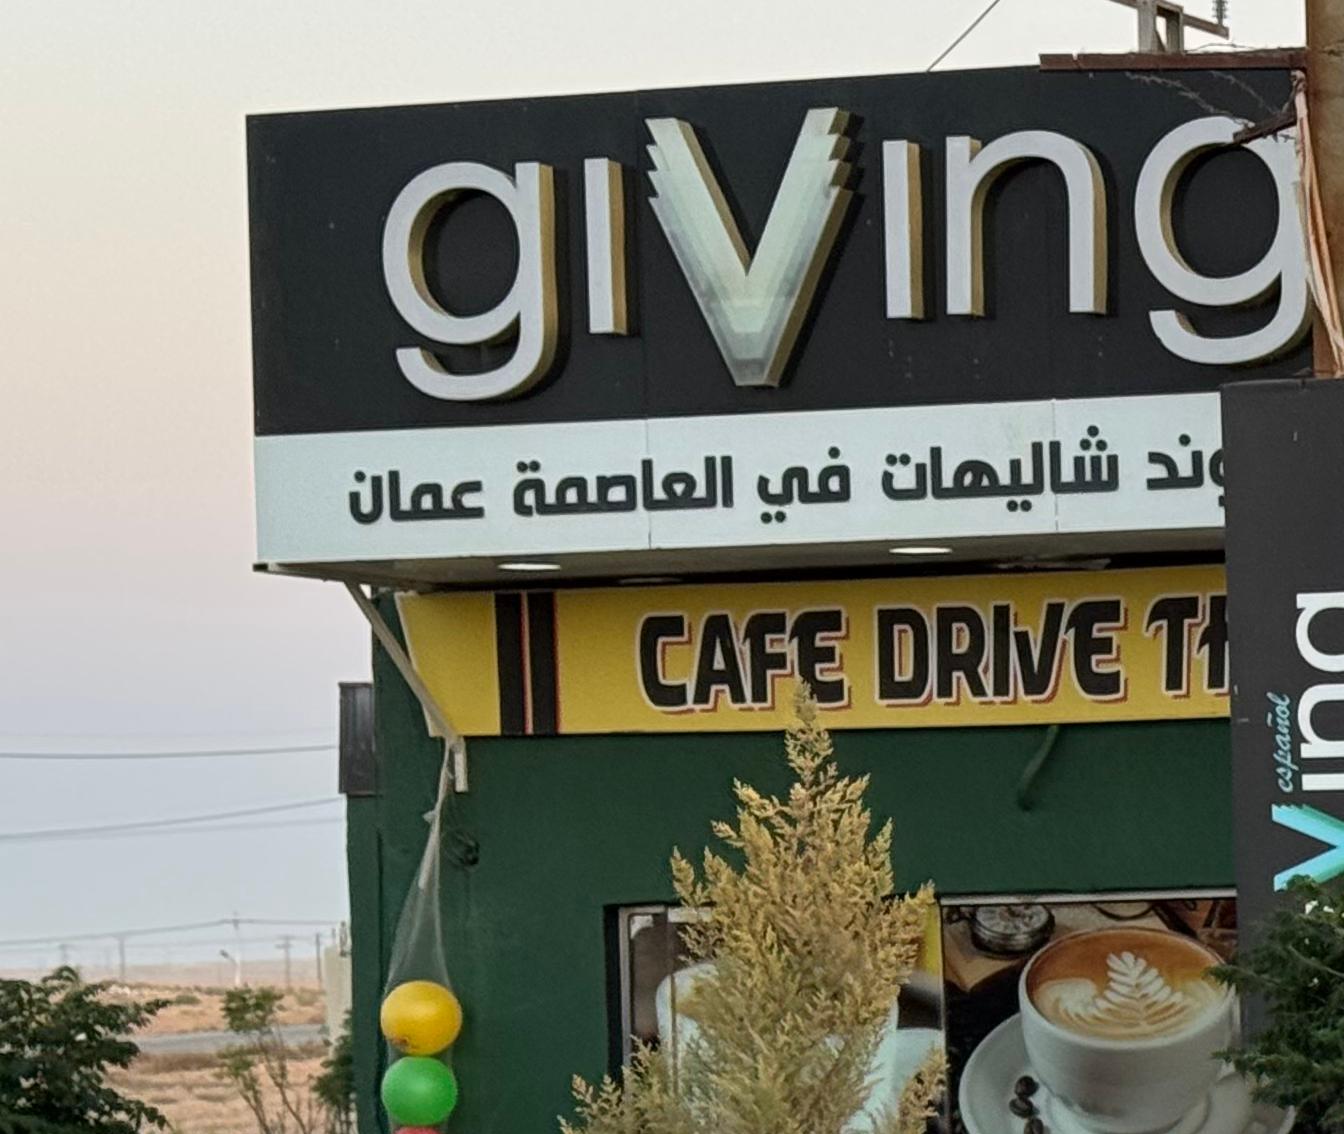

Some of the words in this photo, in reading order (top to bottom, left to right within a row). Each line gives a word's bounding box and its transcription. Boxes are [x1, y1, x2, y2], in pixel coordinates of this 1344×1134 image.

[349, 470, 485, 525] عمان
[513, 456, 734, 517] العاصمة
[757, 447, 851, 524] في
[882, 425, 1120, 513] شاليهات
[637, 608, 852, 711] CAFE
[874, 598, 1128, 707] DRIVE
[1266, 691, 1300, 794] español
